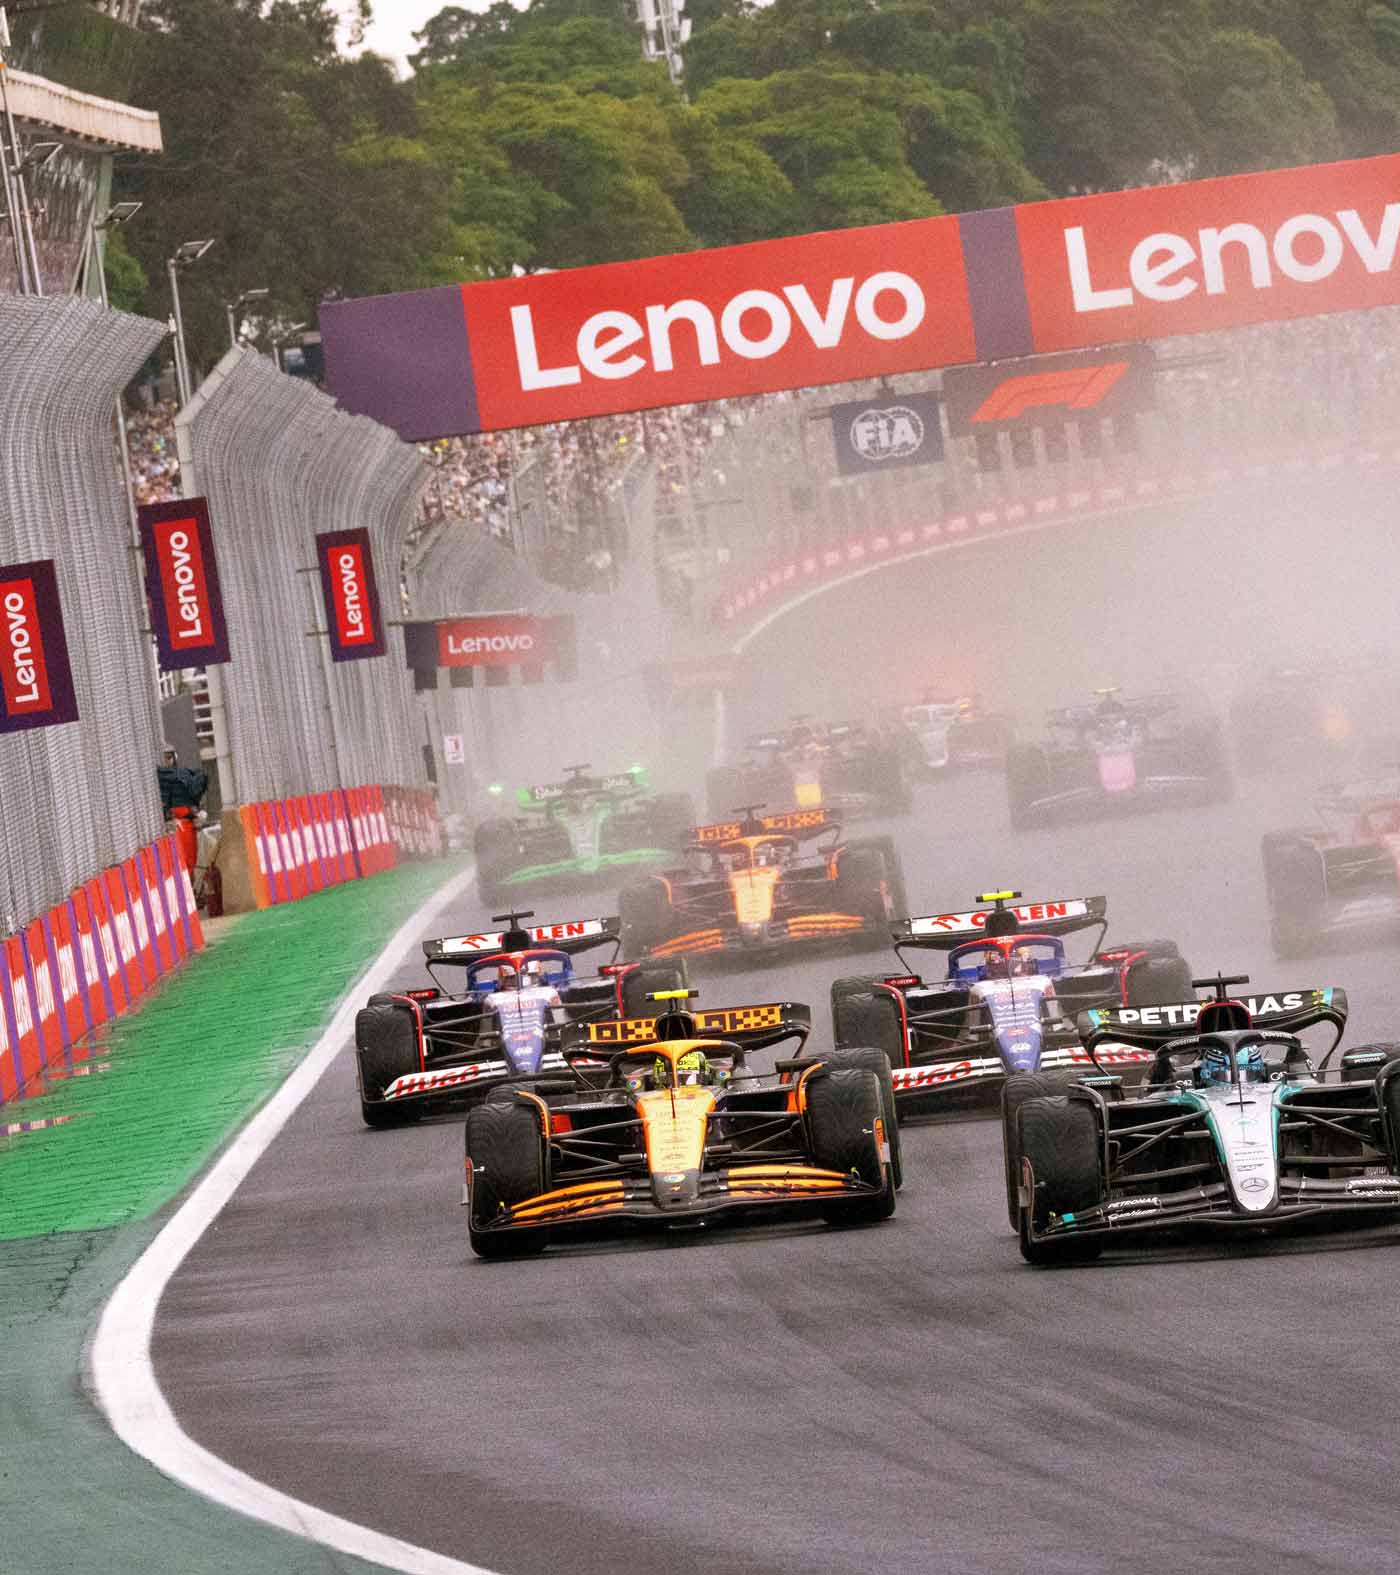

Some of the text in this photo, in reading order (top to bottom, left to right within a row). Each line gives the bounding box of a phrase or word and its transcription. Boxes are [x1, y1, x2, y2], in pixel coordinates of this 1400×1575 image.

[509, 271, 926, 392] Lenovo
[169, 530, 203, 639] Lenovo
[339, 554, 365, 638] Lenovo
[5, 592, 40, 704] Lenovo
[448, 634, 535, 655] Lenovo
[970, 903, 1067, 927] OLEN
